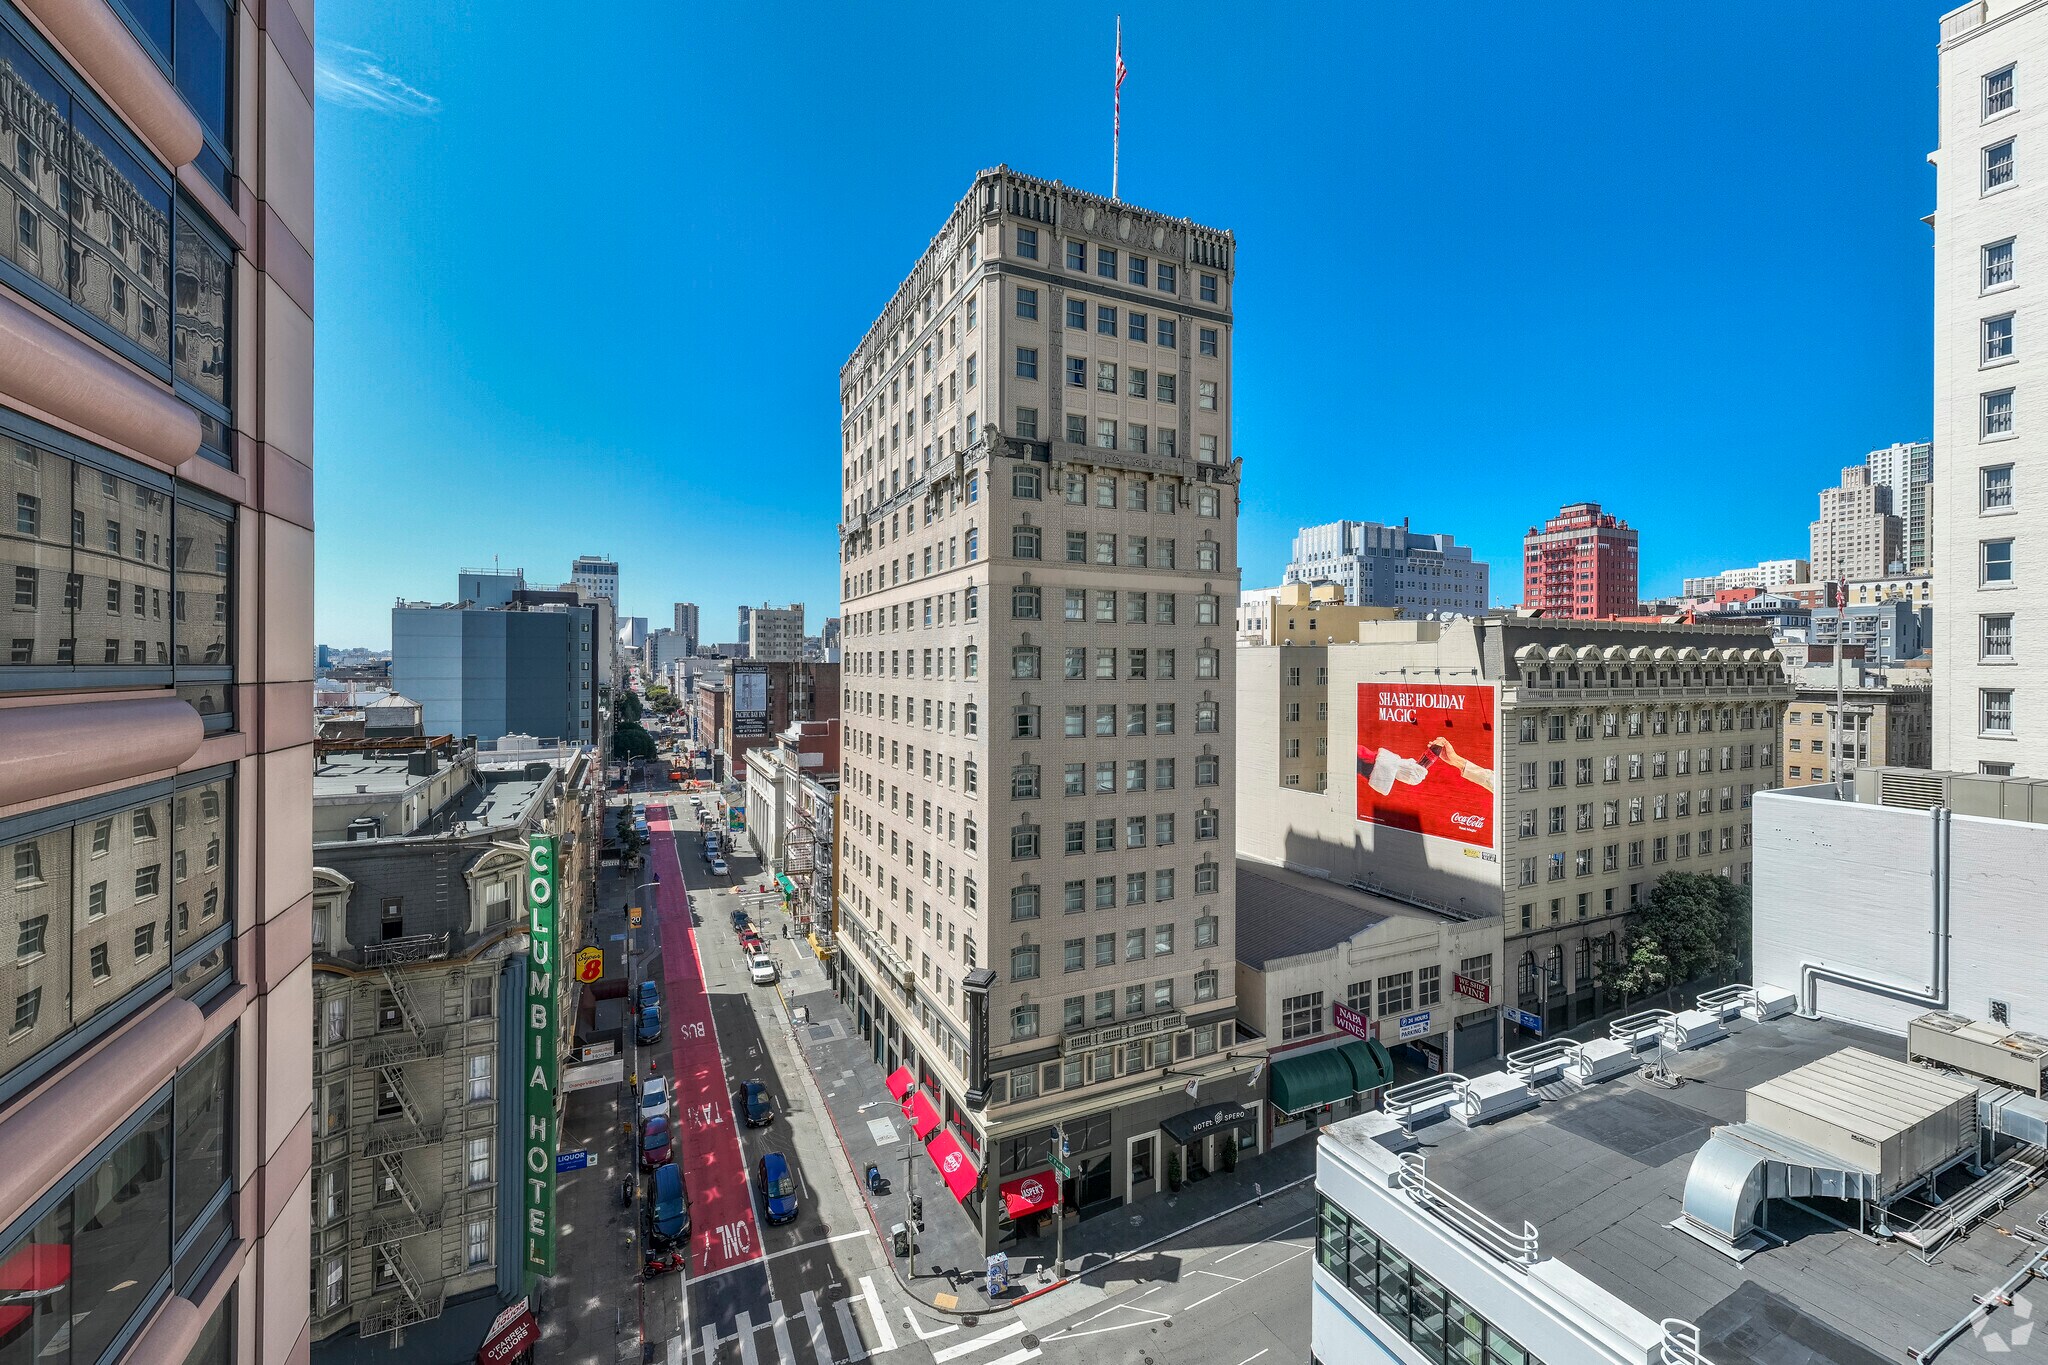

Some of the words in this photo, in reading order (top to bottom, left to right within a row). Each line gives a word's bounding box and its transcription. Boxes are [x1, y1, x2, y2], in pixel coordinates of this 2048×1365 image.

[1378, 692, 1414, 708] SHARE
[1416, 693, 1466, 710] HOLIDAY
[1378, 708, 1417, 723] MAGIC
[1451, 812, 1485, 829] Coca-Cola
[577, 952, 602, 966] Super
[529, 845, 549, 1092] COLUMBIA
[580, 959, 602, 981] 8
[1458, 984, 1486, 1001] WINE
[1459, 978, 1469, 988] WE
[1470, 981, 1486, 992] SHIP
[1339, 1007, 1362, 1026] NAPA
[1414, 1013, 1429, 1022] HOURS
[681, 1021, 706, 1040] BUS
[1336, 1016, 1366, 1039] WINES
[1401, 1028, 1422, 1038] PARKING
[1193, 1120, 1213, 1132] HOTEL
[1224, 1111, 1245, 1122] SPERO
[557, 1152, 585, 1163] LIQUOR
[527, 1115, 548, 1266] HOTEL
[1022, 1184, 1045, 1199] JASPER'S
[488, 1322, 530, 1358] O'FARRELL
[495, 1329, 529, 1361] LIQUORS
